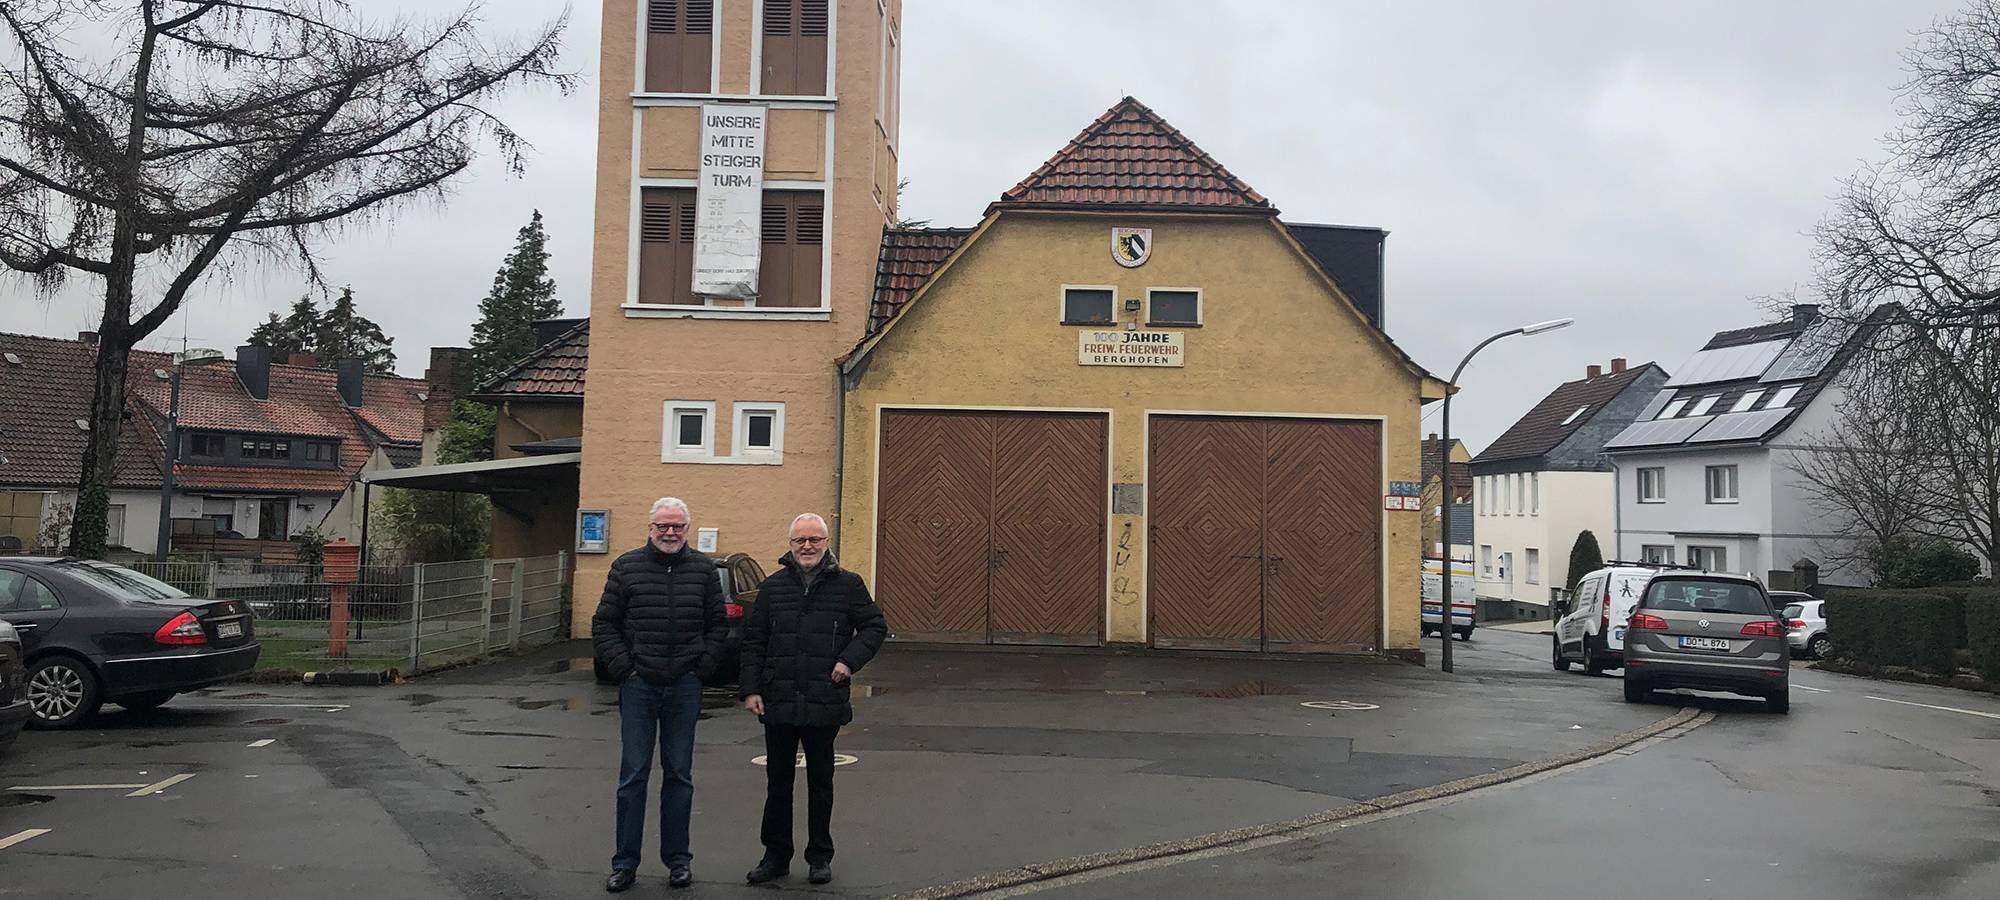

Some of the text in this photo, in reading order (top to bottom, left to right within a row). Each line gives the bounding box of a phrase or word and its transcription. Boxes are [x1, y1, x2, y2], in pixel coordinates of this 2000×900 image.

[707, 116, 761, 129] UNSERE
[712, 135, 754, 148] MITTE
[703, 154, 761, 168] STEIGER
[712, 174, 752, 187] TURM
[1121, 332, 1170, 343] JAHRE
[1084, 344, 1179, 355] FREIW. FEUERWEHR
[1094, 355, 1169, 364] BERGHOFEN
[1710, 639, 1727, 648] 876
